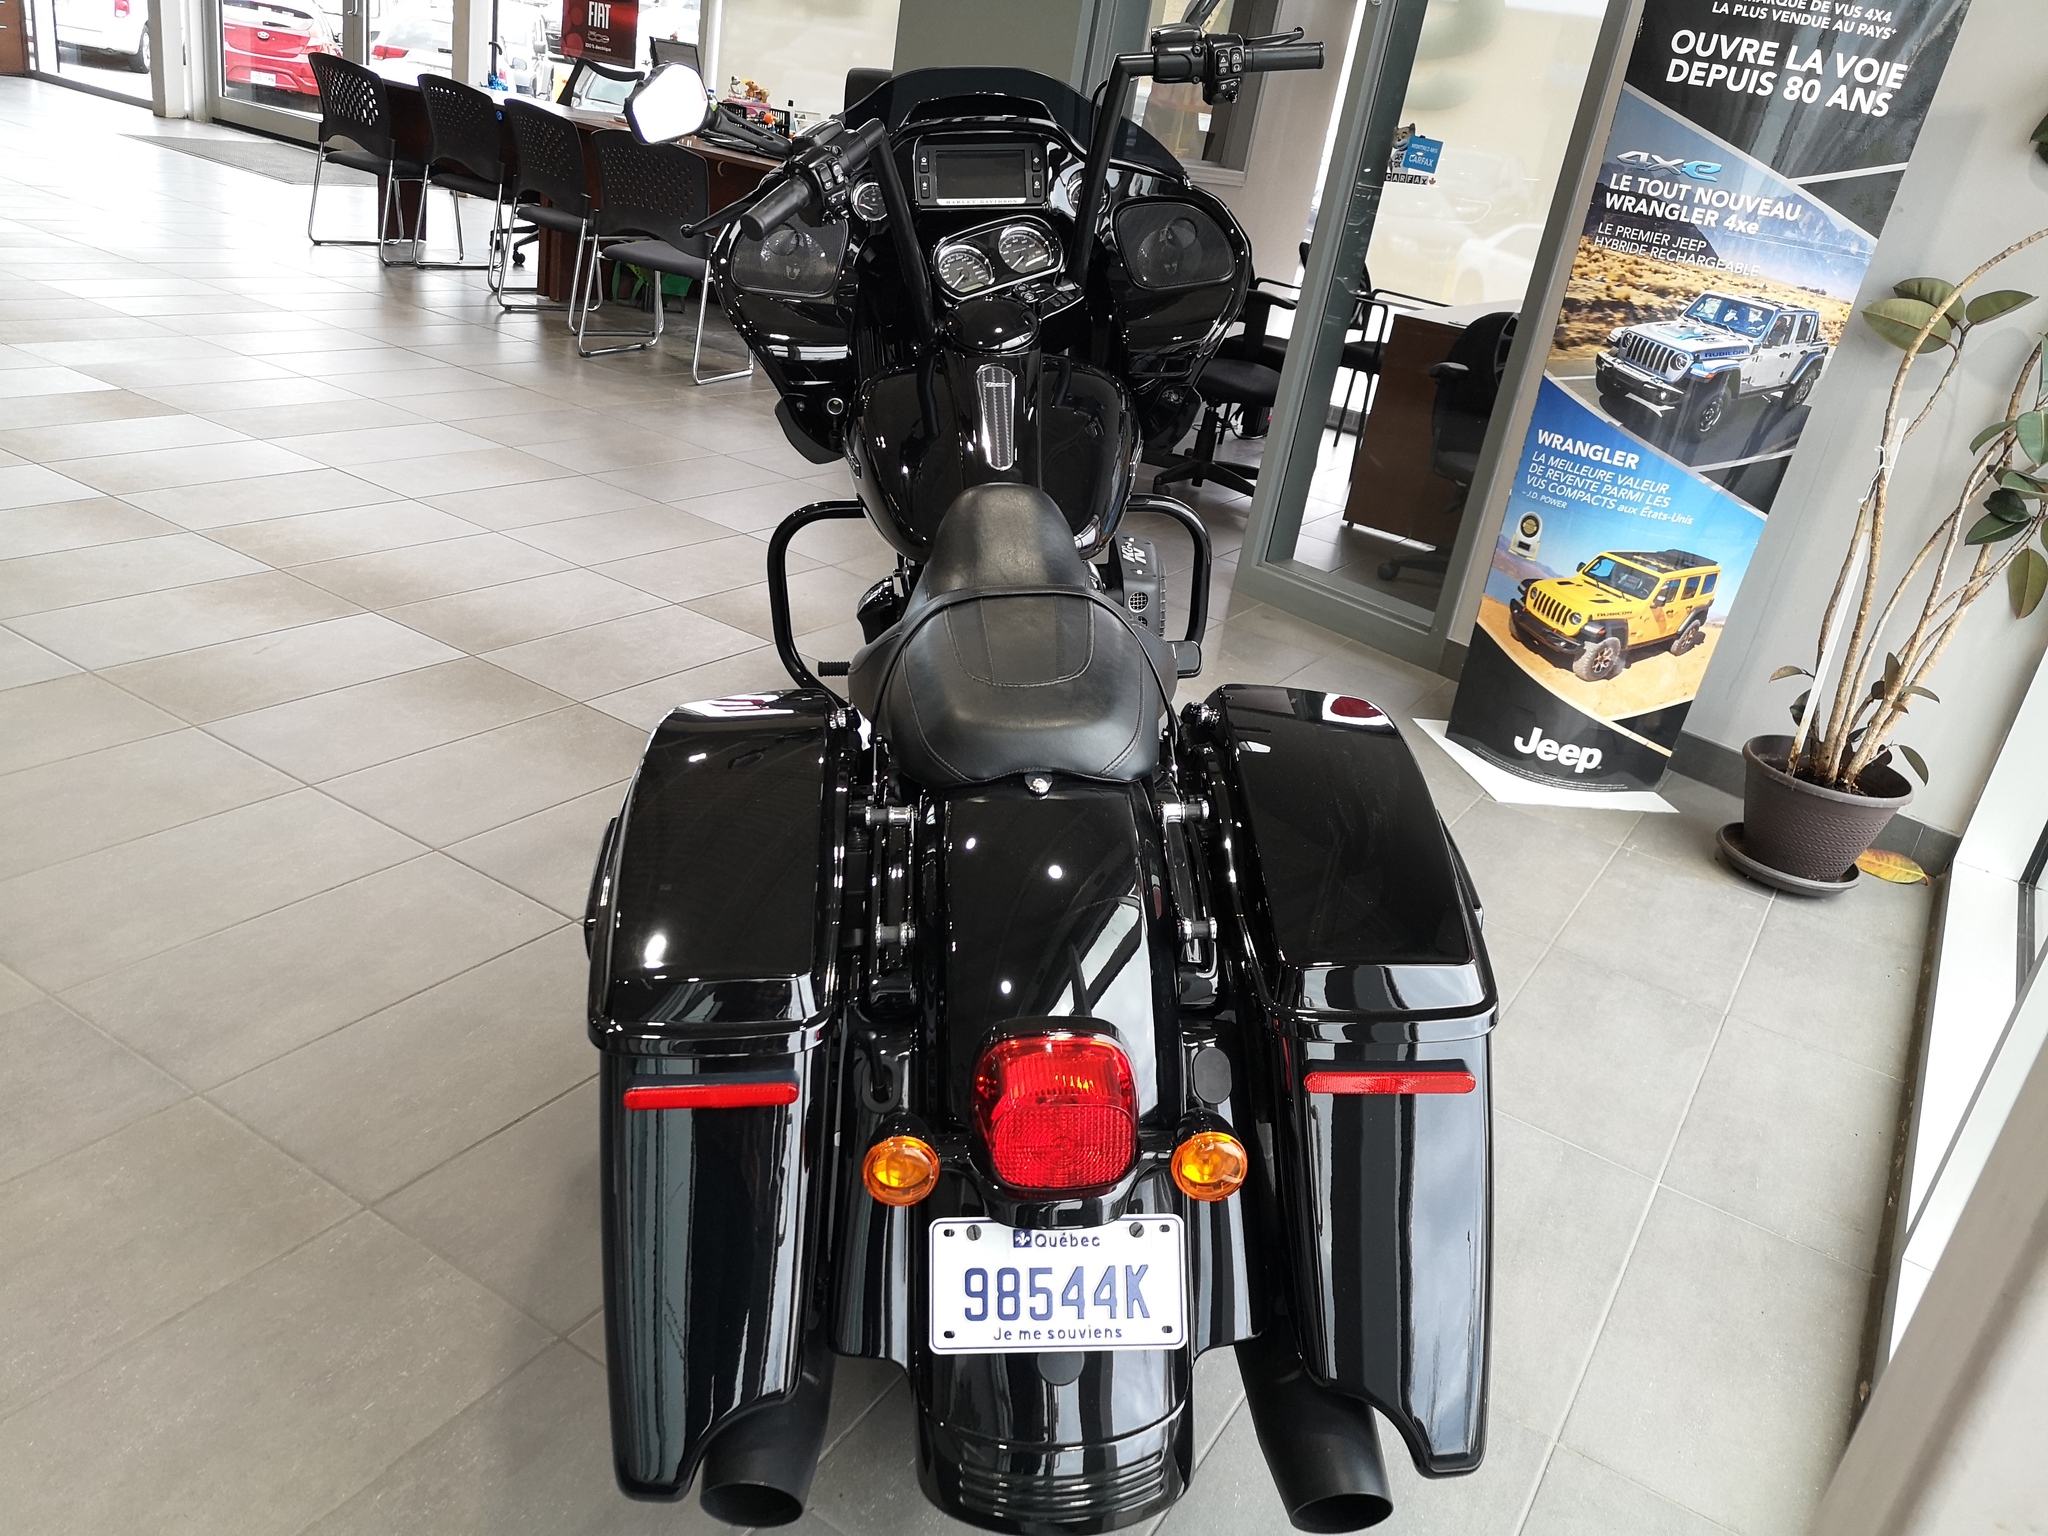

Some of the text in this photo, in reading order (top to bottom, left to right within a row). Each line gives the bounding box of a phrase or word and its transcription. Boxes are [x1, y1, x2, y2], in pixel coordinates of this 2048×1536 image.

[588, 1, 611, 29] FIAT
[1712, 1, 1729, 15] LA
[1732, 4, 1768, 20] PLUS
[1772, 8, 1831, 29] VENDUE
[1832, 18, 1855, 33] AU
[1809, 0, 1831, 13] DE
[1834, 2, 1863, 19] VUS
[1864, 8, 1893, 24] 4X4
[1671, 29, 1908, 90] OUVRE LA VOIE
[1666, 58, 1893, 118] DEPUIS 80 ANS
[1385, 173, 1428, 185] CARFAX
[1408, 154, 1434, 167] CARFAX
[1605, 192, 1760, 235] WRANGLER 4xe
[1609, 173, 1802, 221] LE TOUT NOUVEAU
[1594, 236, 1760, 277] HYBRIDE RECHARGEABLE
[1598, 222, 1707, 251] LE PREMIER JEEP
[1537, 429, 1640, 470] WRANGLER
[1528, 462, 1671, 508] DE REVENTE PARMI LES
[1532, 450, 1670, 495] LA MEILLEURE VALEUR
[1526, 474, 1694, 525] VUS COMPACTS aux États-Unis
[1539, 494, 1567, 509] POWER
[1513, 726, 1603, 773] Jeep
[1034, 1232, 1100, 1247] Québec
[964, 1264, 1150, 1321] 98544K
[993, 1325, 1122, 1341] Je me souviens
